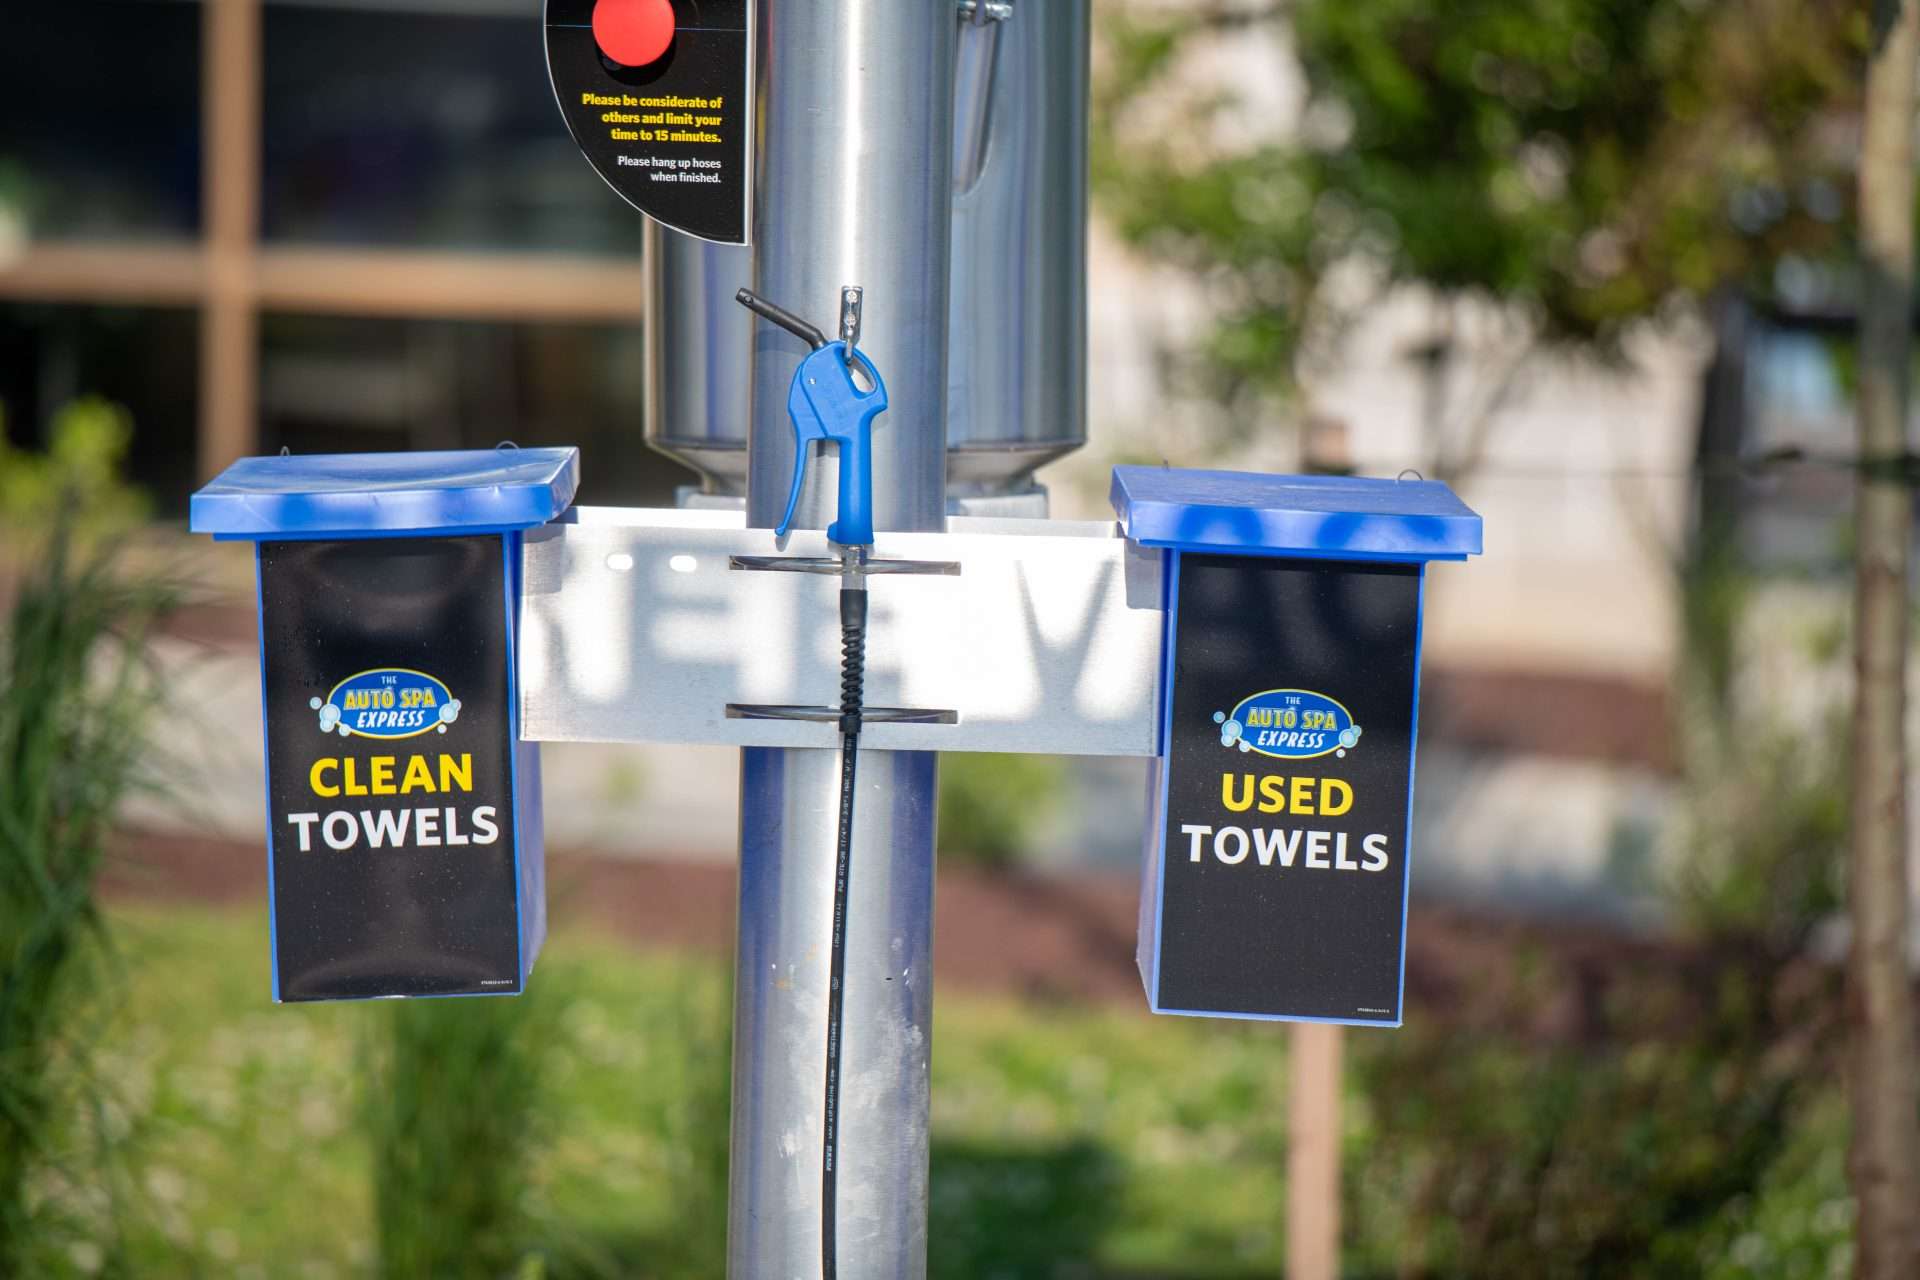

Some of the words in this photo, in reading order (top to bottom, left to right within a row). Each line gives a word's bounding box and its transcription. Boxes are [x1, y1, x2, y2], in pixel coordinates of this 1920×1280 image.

[582, 92, 622, 106] Please
[623, 94, 638, 107] be
[639, 94, 708, 108] considerate
[709, 96, 723, 109] of
[602, 112, 640, 123] others
[642, 112, 665, 124] and
[666, 112, 693, 125] limit
[695, 115, 722, 127] your
[611, 128, 639, 141] time
[640, 129, 652, 141] to
[655, 130, 668, 141] 15
[671, 131, 722, 143] minutes.
[618, 156, 650, 166] Please
[651, 157, 676, 169] hang
[678, 159, 691, 169] up
[692, 159, 721, 168] hoses
[651, 172, 677, 182] when
[679, 173, 721, 183] finished.
[381, 676, 397, 684] THE
[399, 687, 437, 707] SPA
[1286, 696, 1301, 704] THE
[357, 710, 424, 729] EXPRESS
[1301, 710, 1337, 731] SPA
[1257, 731, 1325, 748] EXPRESS
[309, 754, 473, 797] CLEAN
[1221, 773, 1354, 816] USED
[288, 806, 499, 852] TOWELS
[1181, 825, 1389, 872] TOWELS
